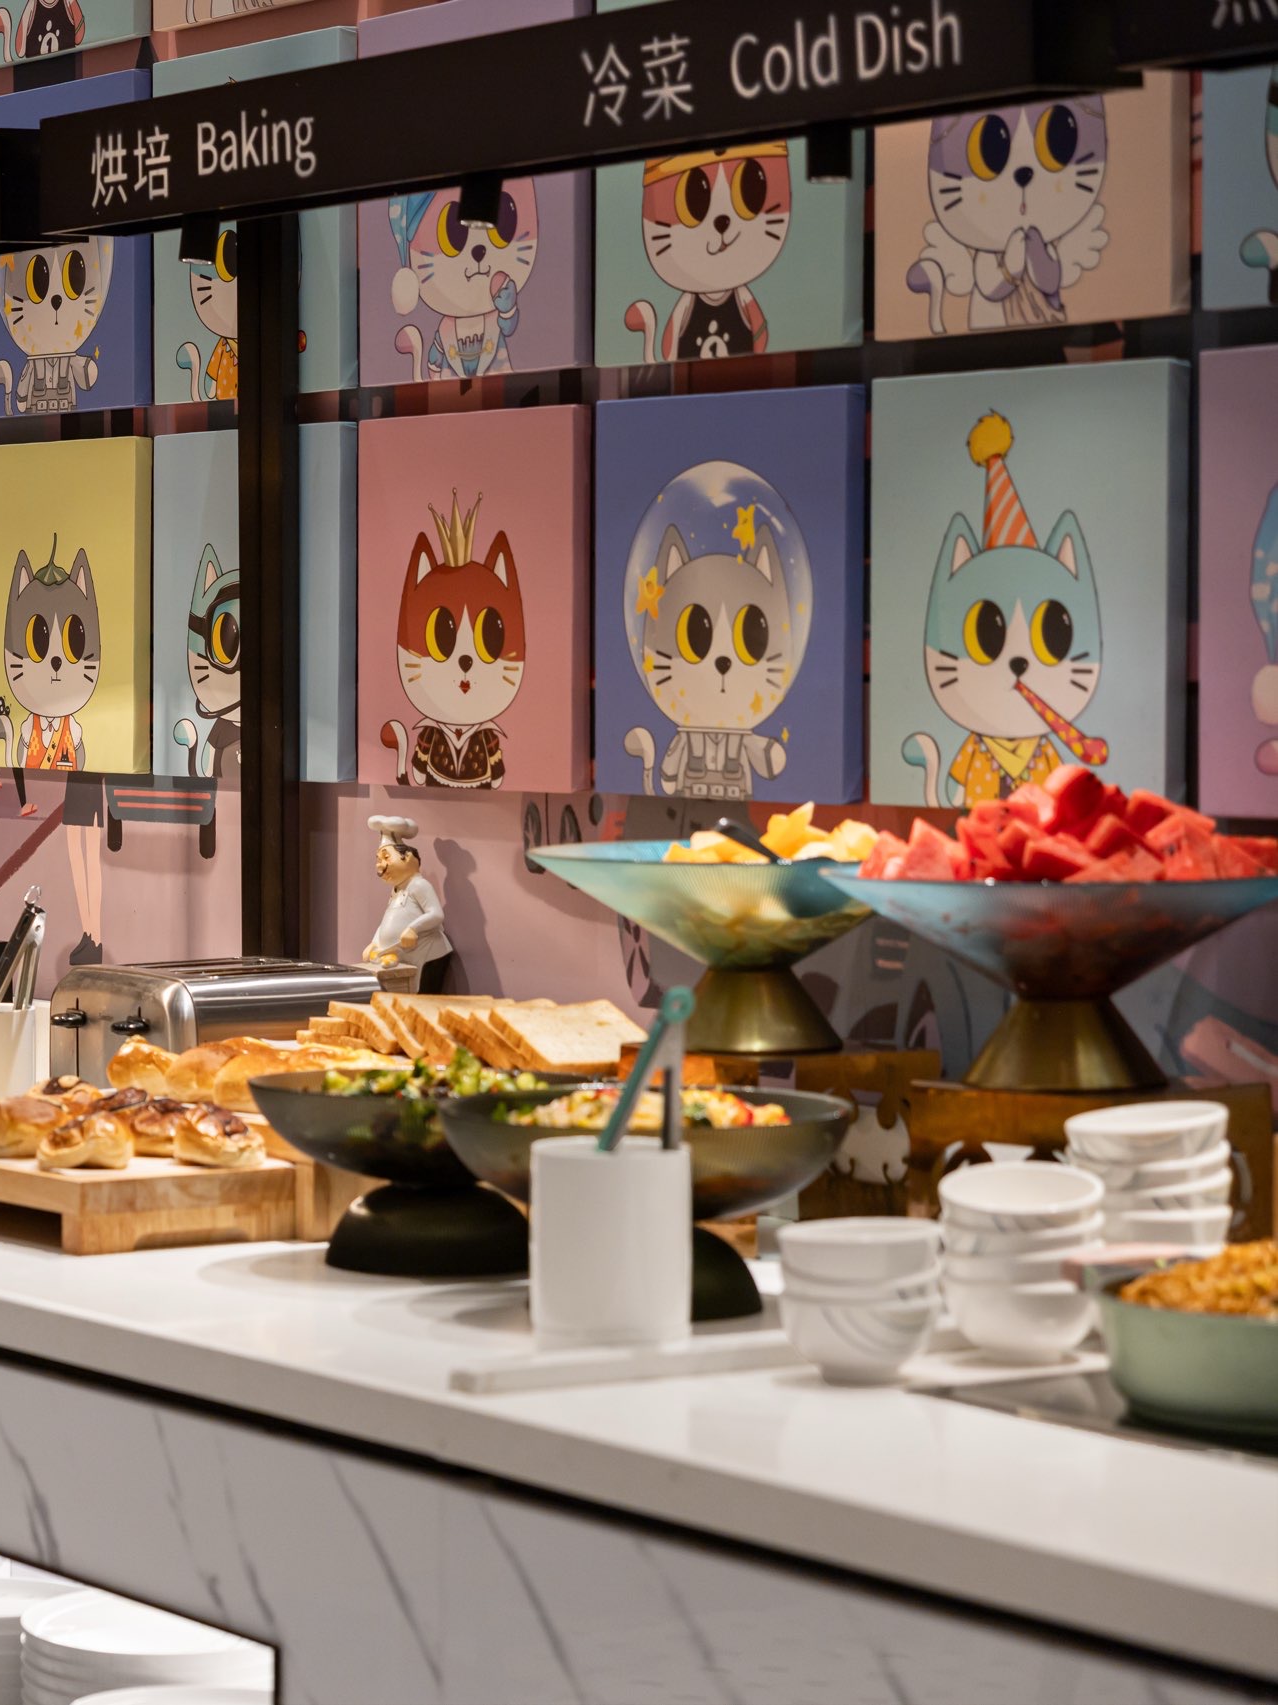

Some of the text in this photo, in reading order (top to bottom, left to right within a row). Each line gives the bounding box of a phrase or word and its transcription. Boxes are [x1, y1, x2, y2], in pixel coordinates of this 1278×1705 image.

[581, 10, 963, 127] 冷菜 Cold Dish
[91, 108, 316, 208] 烘培 Baking
